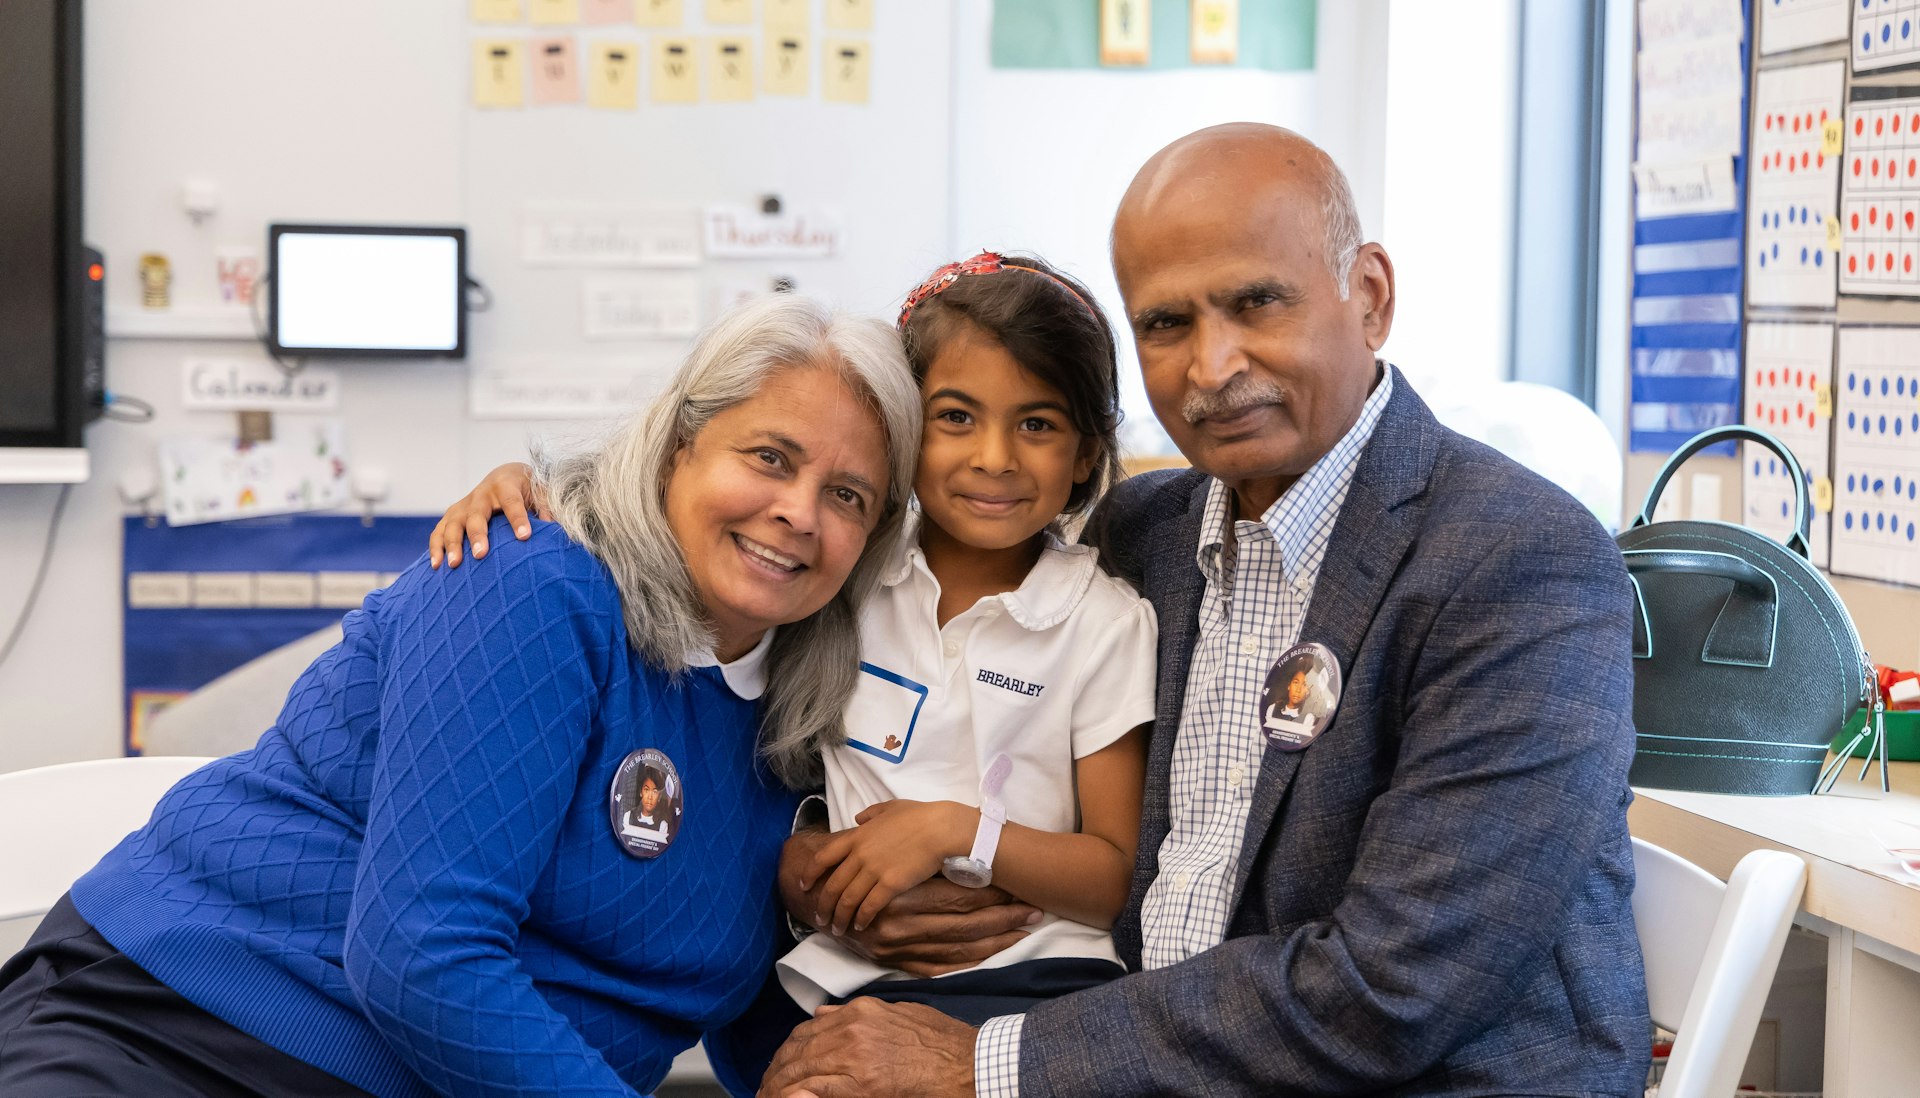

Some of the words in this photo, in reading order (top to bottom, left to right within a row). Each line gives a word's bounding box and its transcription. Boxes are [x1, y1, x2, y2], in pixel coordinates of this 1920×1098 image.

[709, 211, 839, 257] Thursday
[190, 363, 328, 398] Calendar
[976, 668, 1045, 697] BREARLEY
[624, 760, 636, 774] THE
[634, 753, 663, 763] BREARLEY
[662, 759, 678, 785] SCHOOL
